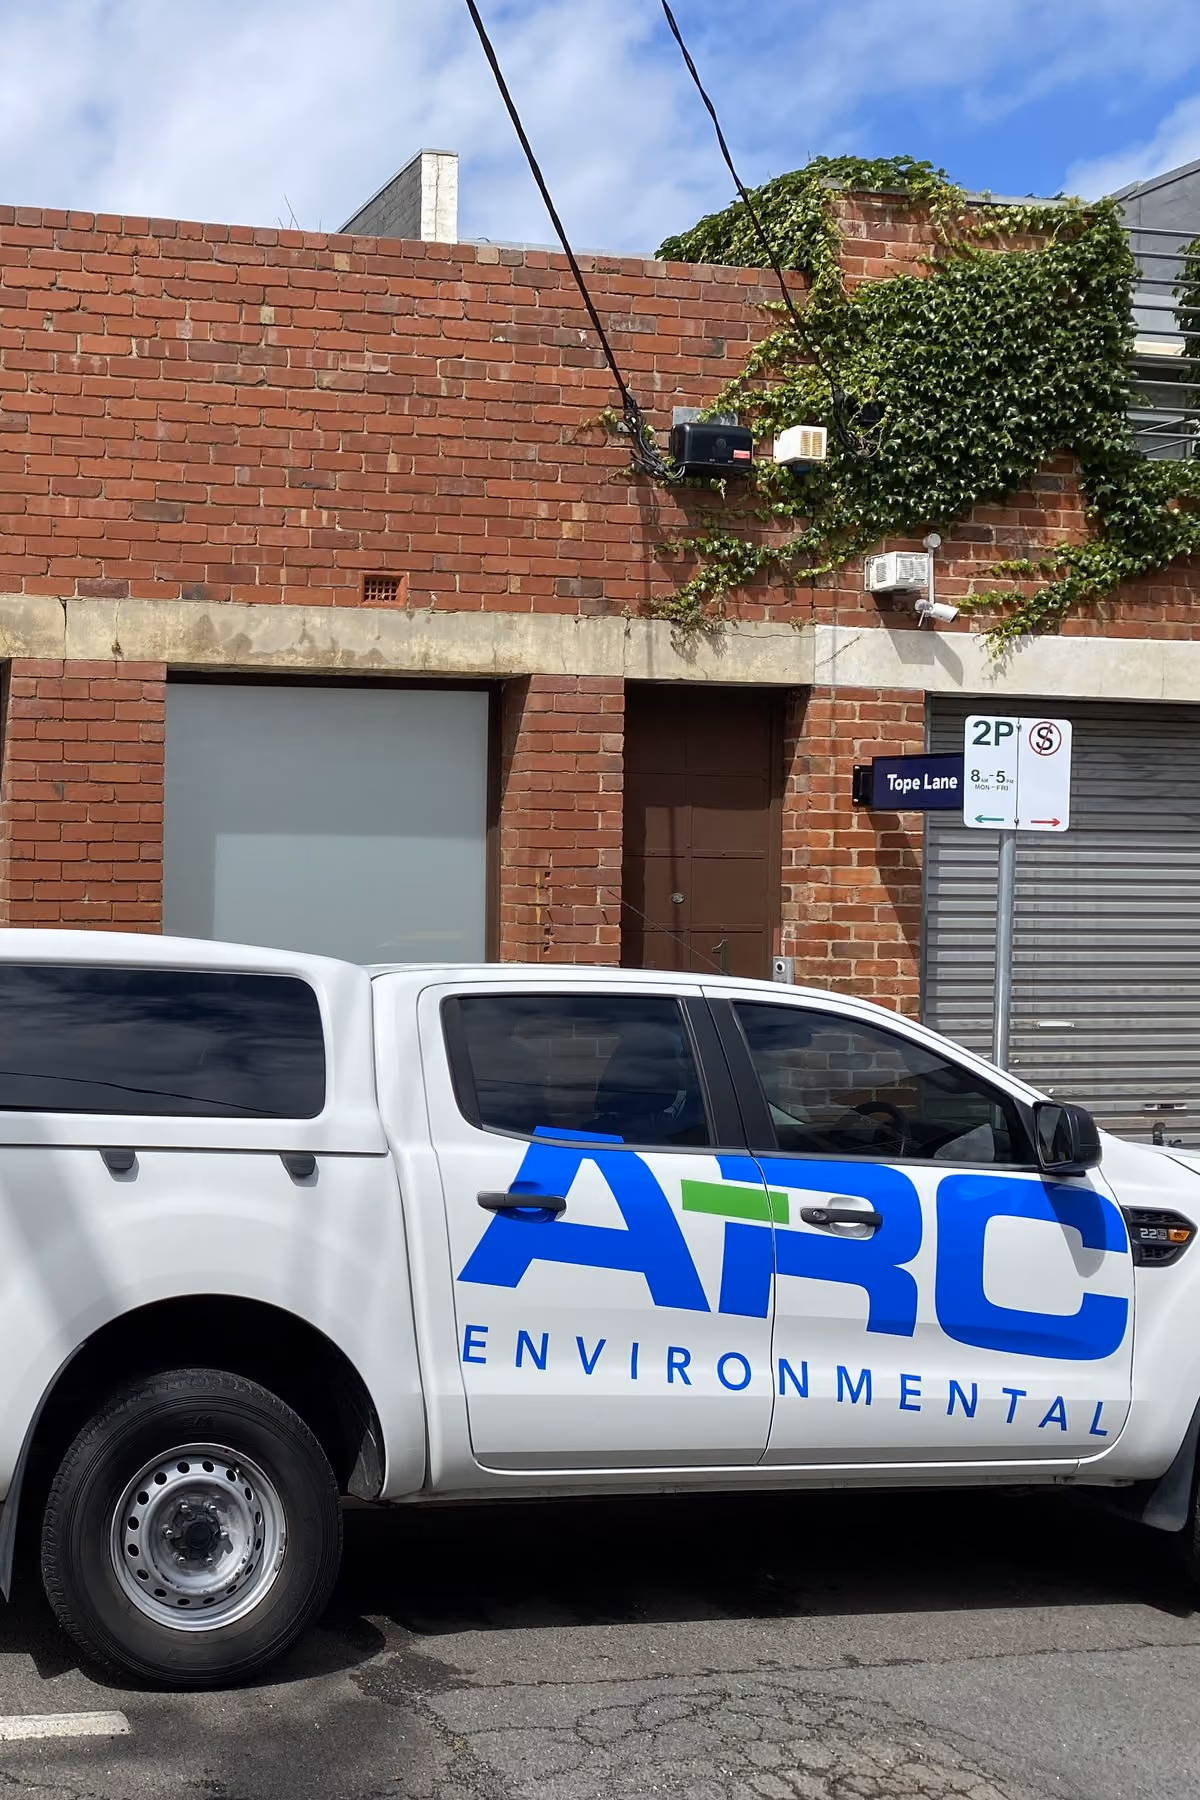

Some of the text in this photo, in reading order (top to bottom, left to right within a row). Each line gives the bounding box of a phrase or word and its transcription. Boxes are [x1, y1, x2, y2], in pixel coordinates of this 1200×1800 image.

[972, 720, 1014, 746] 2P
[887, 773, 958, 794] Tope Lane
[457, 1125, 1129, 1361] ARC
[462, 1324, 1109, 1438] ENVIRONMENTAL
